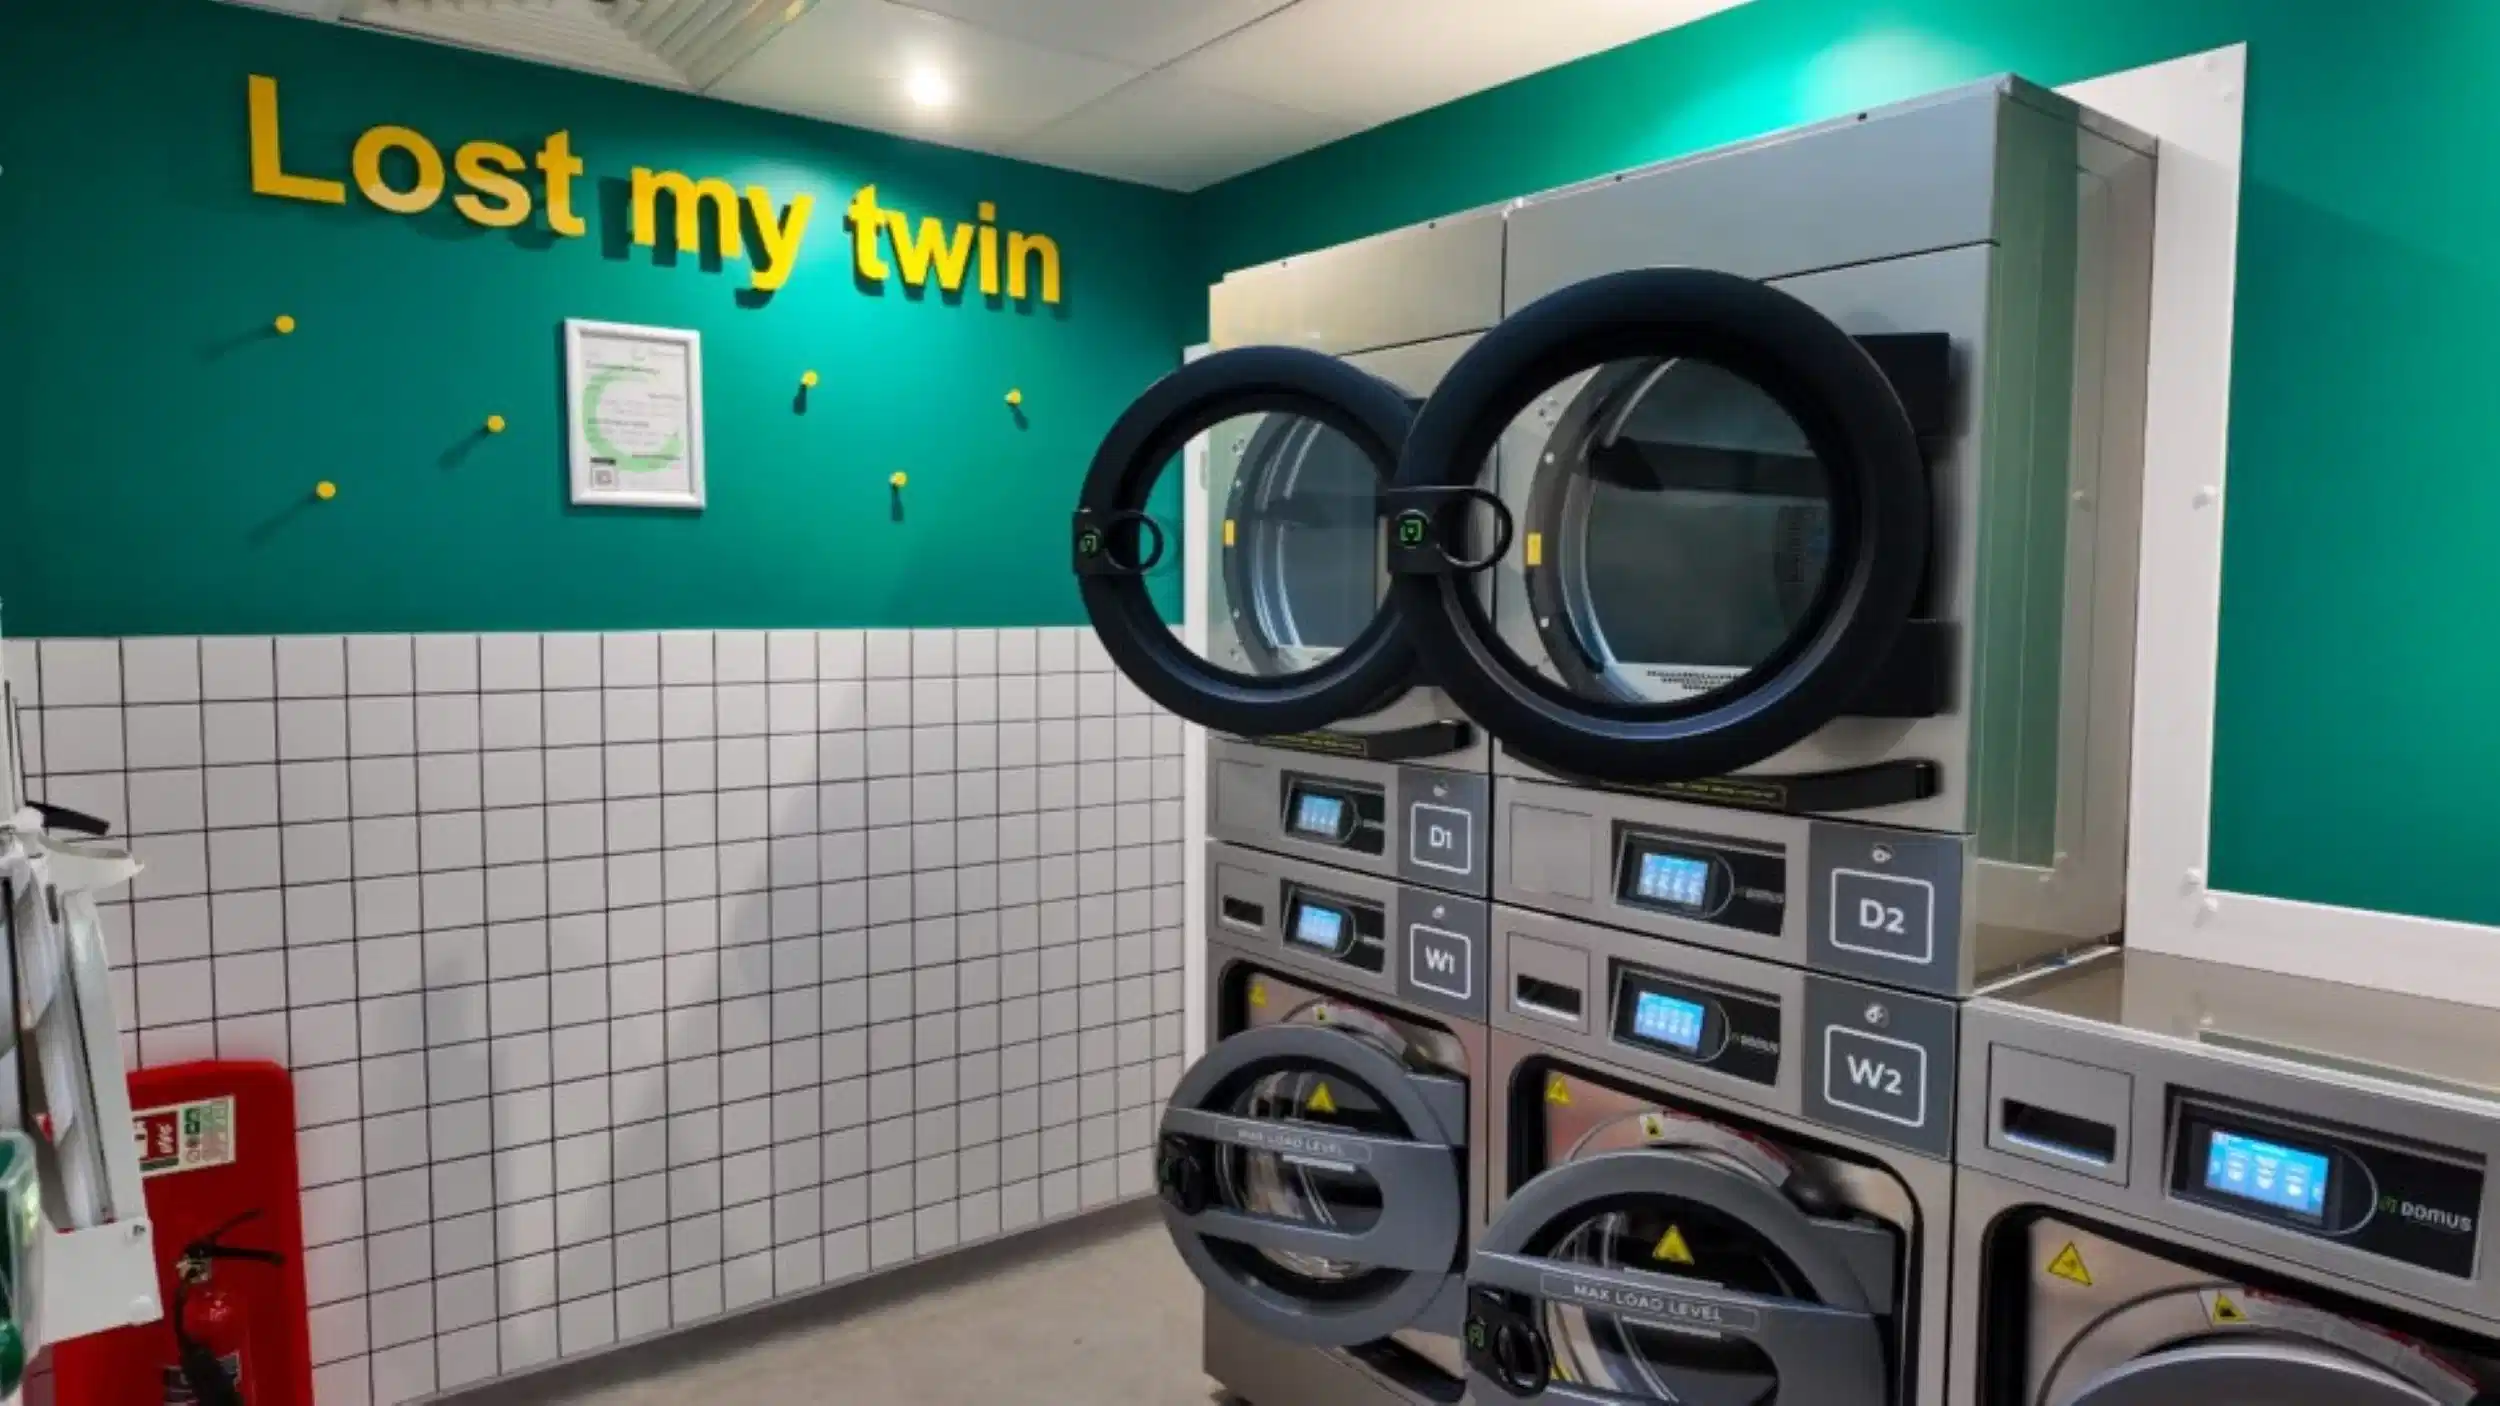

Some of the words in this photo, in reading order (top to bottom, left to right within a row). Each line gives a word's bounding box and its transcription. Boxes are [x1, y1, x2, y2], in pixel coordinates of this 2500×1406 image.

[249, 73, 586, 237] Lost
[631, 166, 816, 291] my
[848, 184, 1060, 304] twin
[1429, 824, 1453, 849] D1
[1859, 897, 1905, 935] D2
[1424, 945, 1455, 975] W1
[1847, 1054, 1904, 1097] W2
[1573, 1284, 1610, 1301] MAX
[1615, 1292, 1664, 1312] LOAD
[1669, 1301, 1721, 1321] LEVEL
